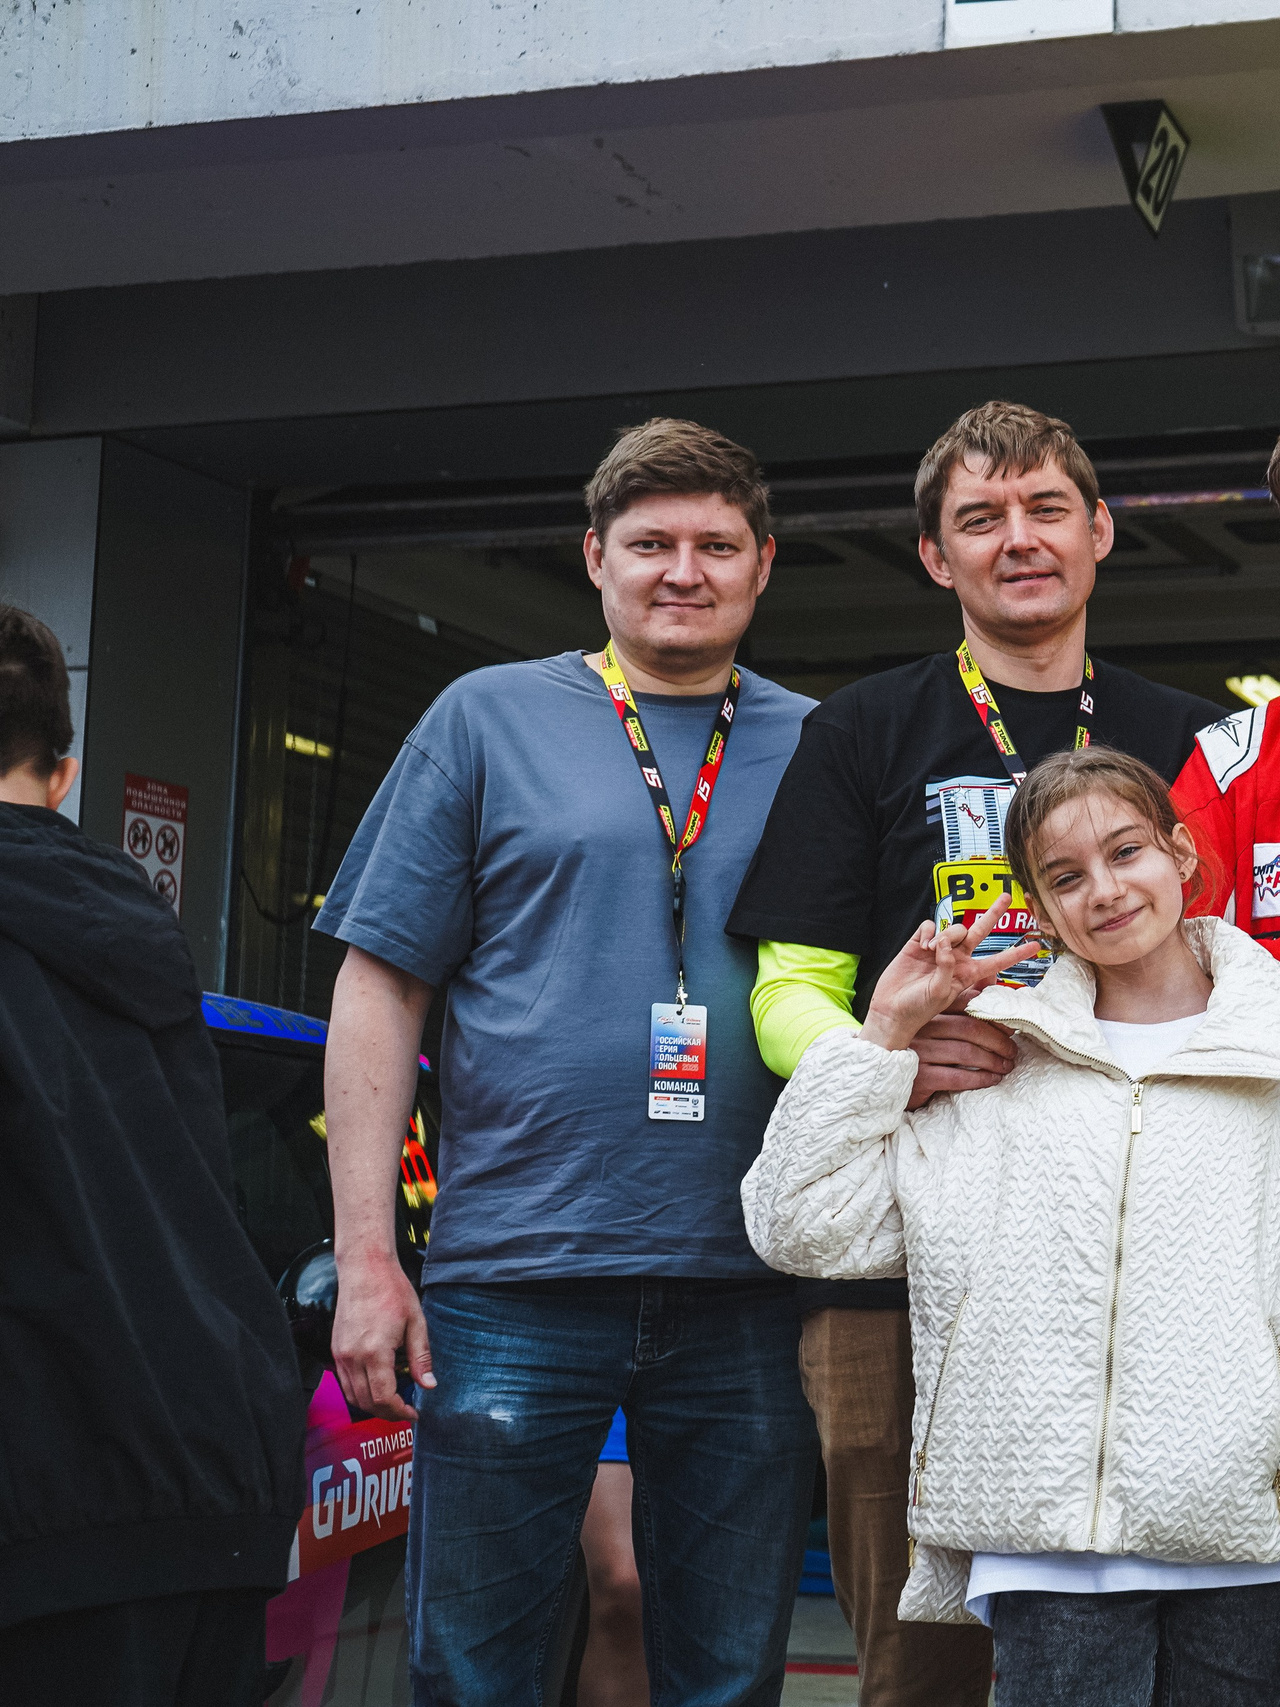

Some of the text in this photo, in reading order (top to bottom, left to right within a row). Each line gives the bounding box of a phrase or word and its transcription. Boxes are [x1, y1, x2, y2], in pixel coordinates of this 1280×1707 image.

[1140, 125, 1179, 217] 20
[609, 682, 630, 701] 15
[970, 683, 992, 704] 15
[721, 698, 734, 723] 15
[1080, 690, 1093, 715] 15
[642, 767, 662, 788] 15
[697, 777, 711, 802] 15
[655, 1035, 701, 1046] РОССИЙСКАЯ
[655, 1045, 678, 1053] СЕРИЯ
[654, 1053, 699, 1063] КОЛЬЦЕВЫХ
[654, 1062, 678, 1070] ГОНОК
[654, 1080, 700, 1093] КОМАНДА
[360, 1429, 413, 1460] ТОПЛИВО
